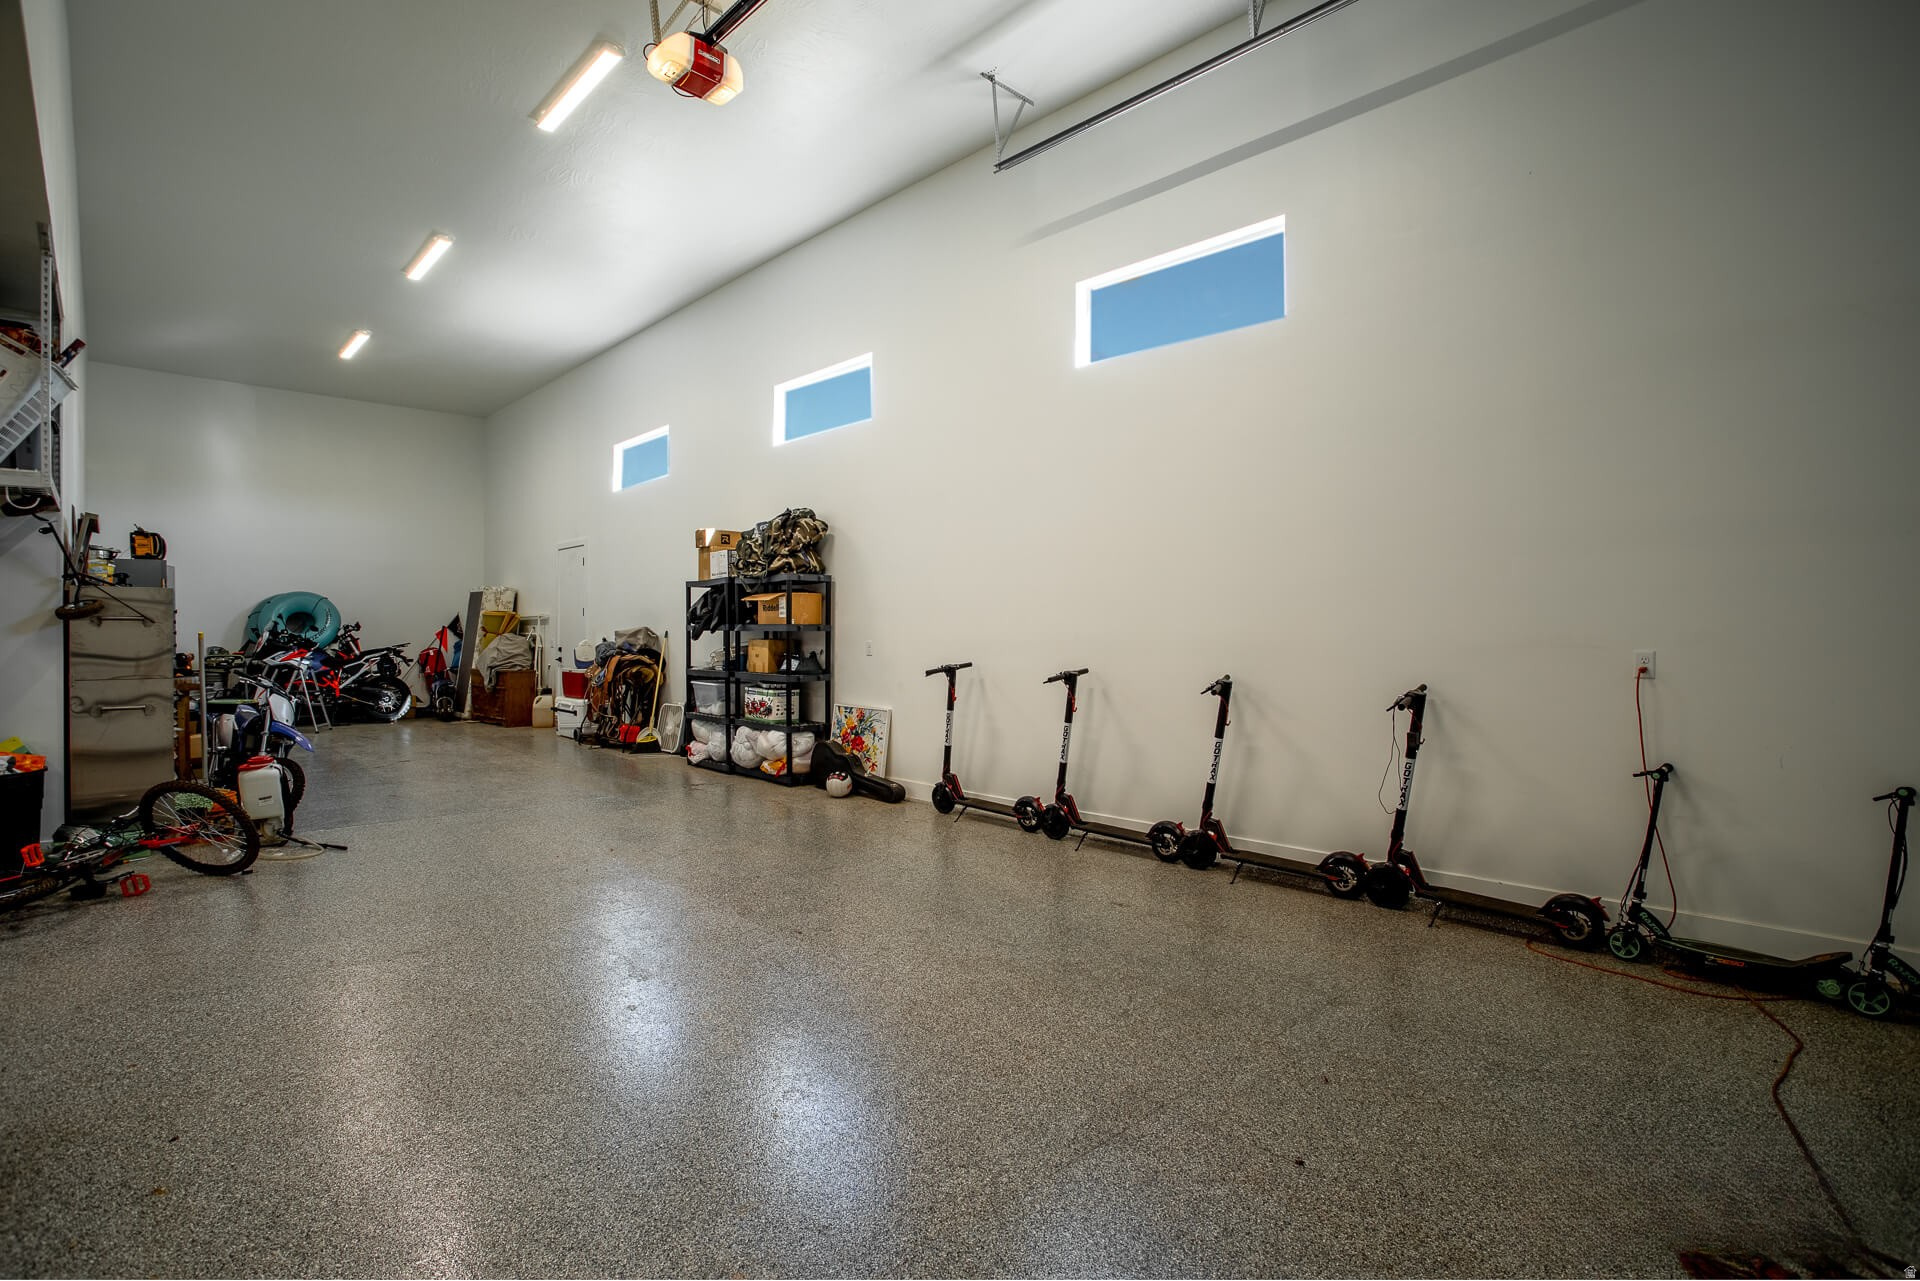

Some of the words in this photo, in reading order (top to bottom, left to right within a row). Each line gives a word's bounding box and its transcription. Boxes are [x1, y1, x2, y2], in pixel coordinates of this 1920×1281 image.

[1060, 725, 1069, 761] GOTRAX
[1209, 741, 1221, 781] GOTRAX
[1398, 761, 1412, 808] GOTRAX
[1640, 911, 1666, 937] Razor
